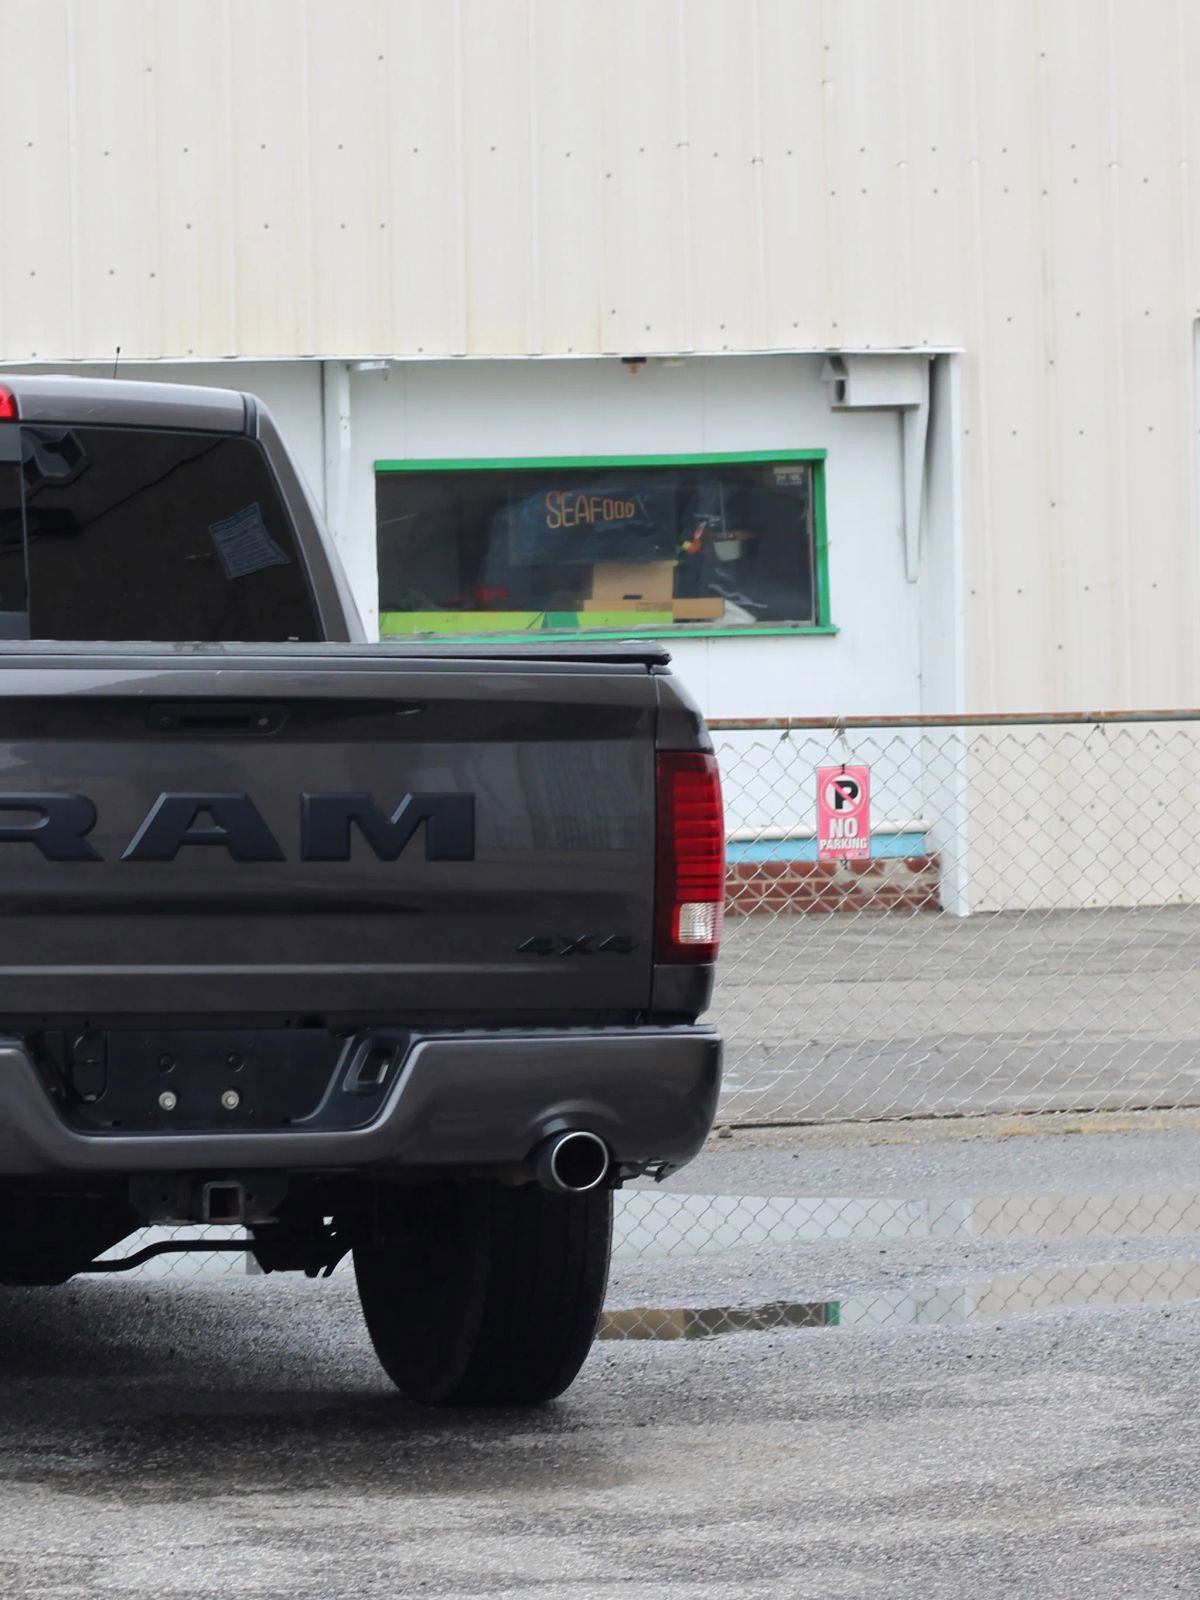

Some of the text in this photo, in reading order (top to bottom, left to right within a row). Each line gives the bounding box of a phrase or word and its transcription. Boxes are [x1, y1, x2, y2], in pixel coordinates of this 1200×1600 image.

[545, 491, 634, 528] SEAFOOD
[829, 818, 858, 838] NO
[820, 838, 867, 851] PARKING
